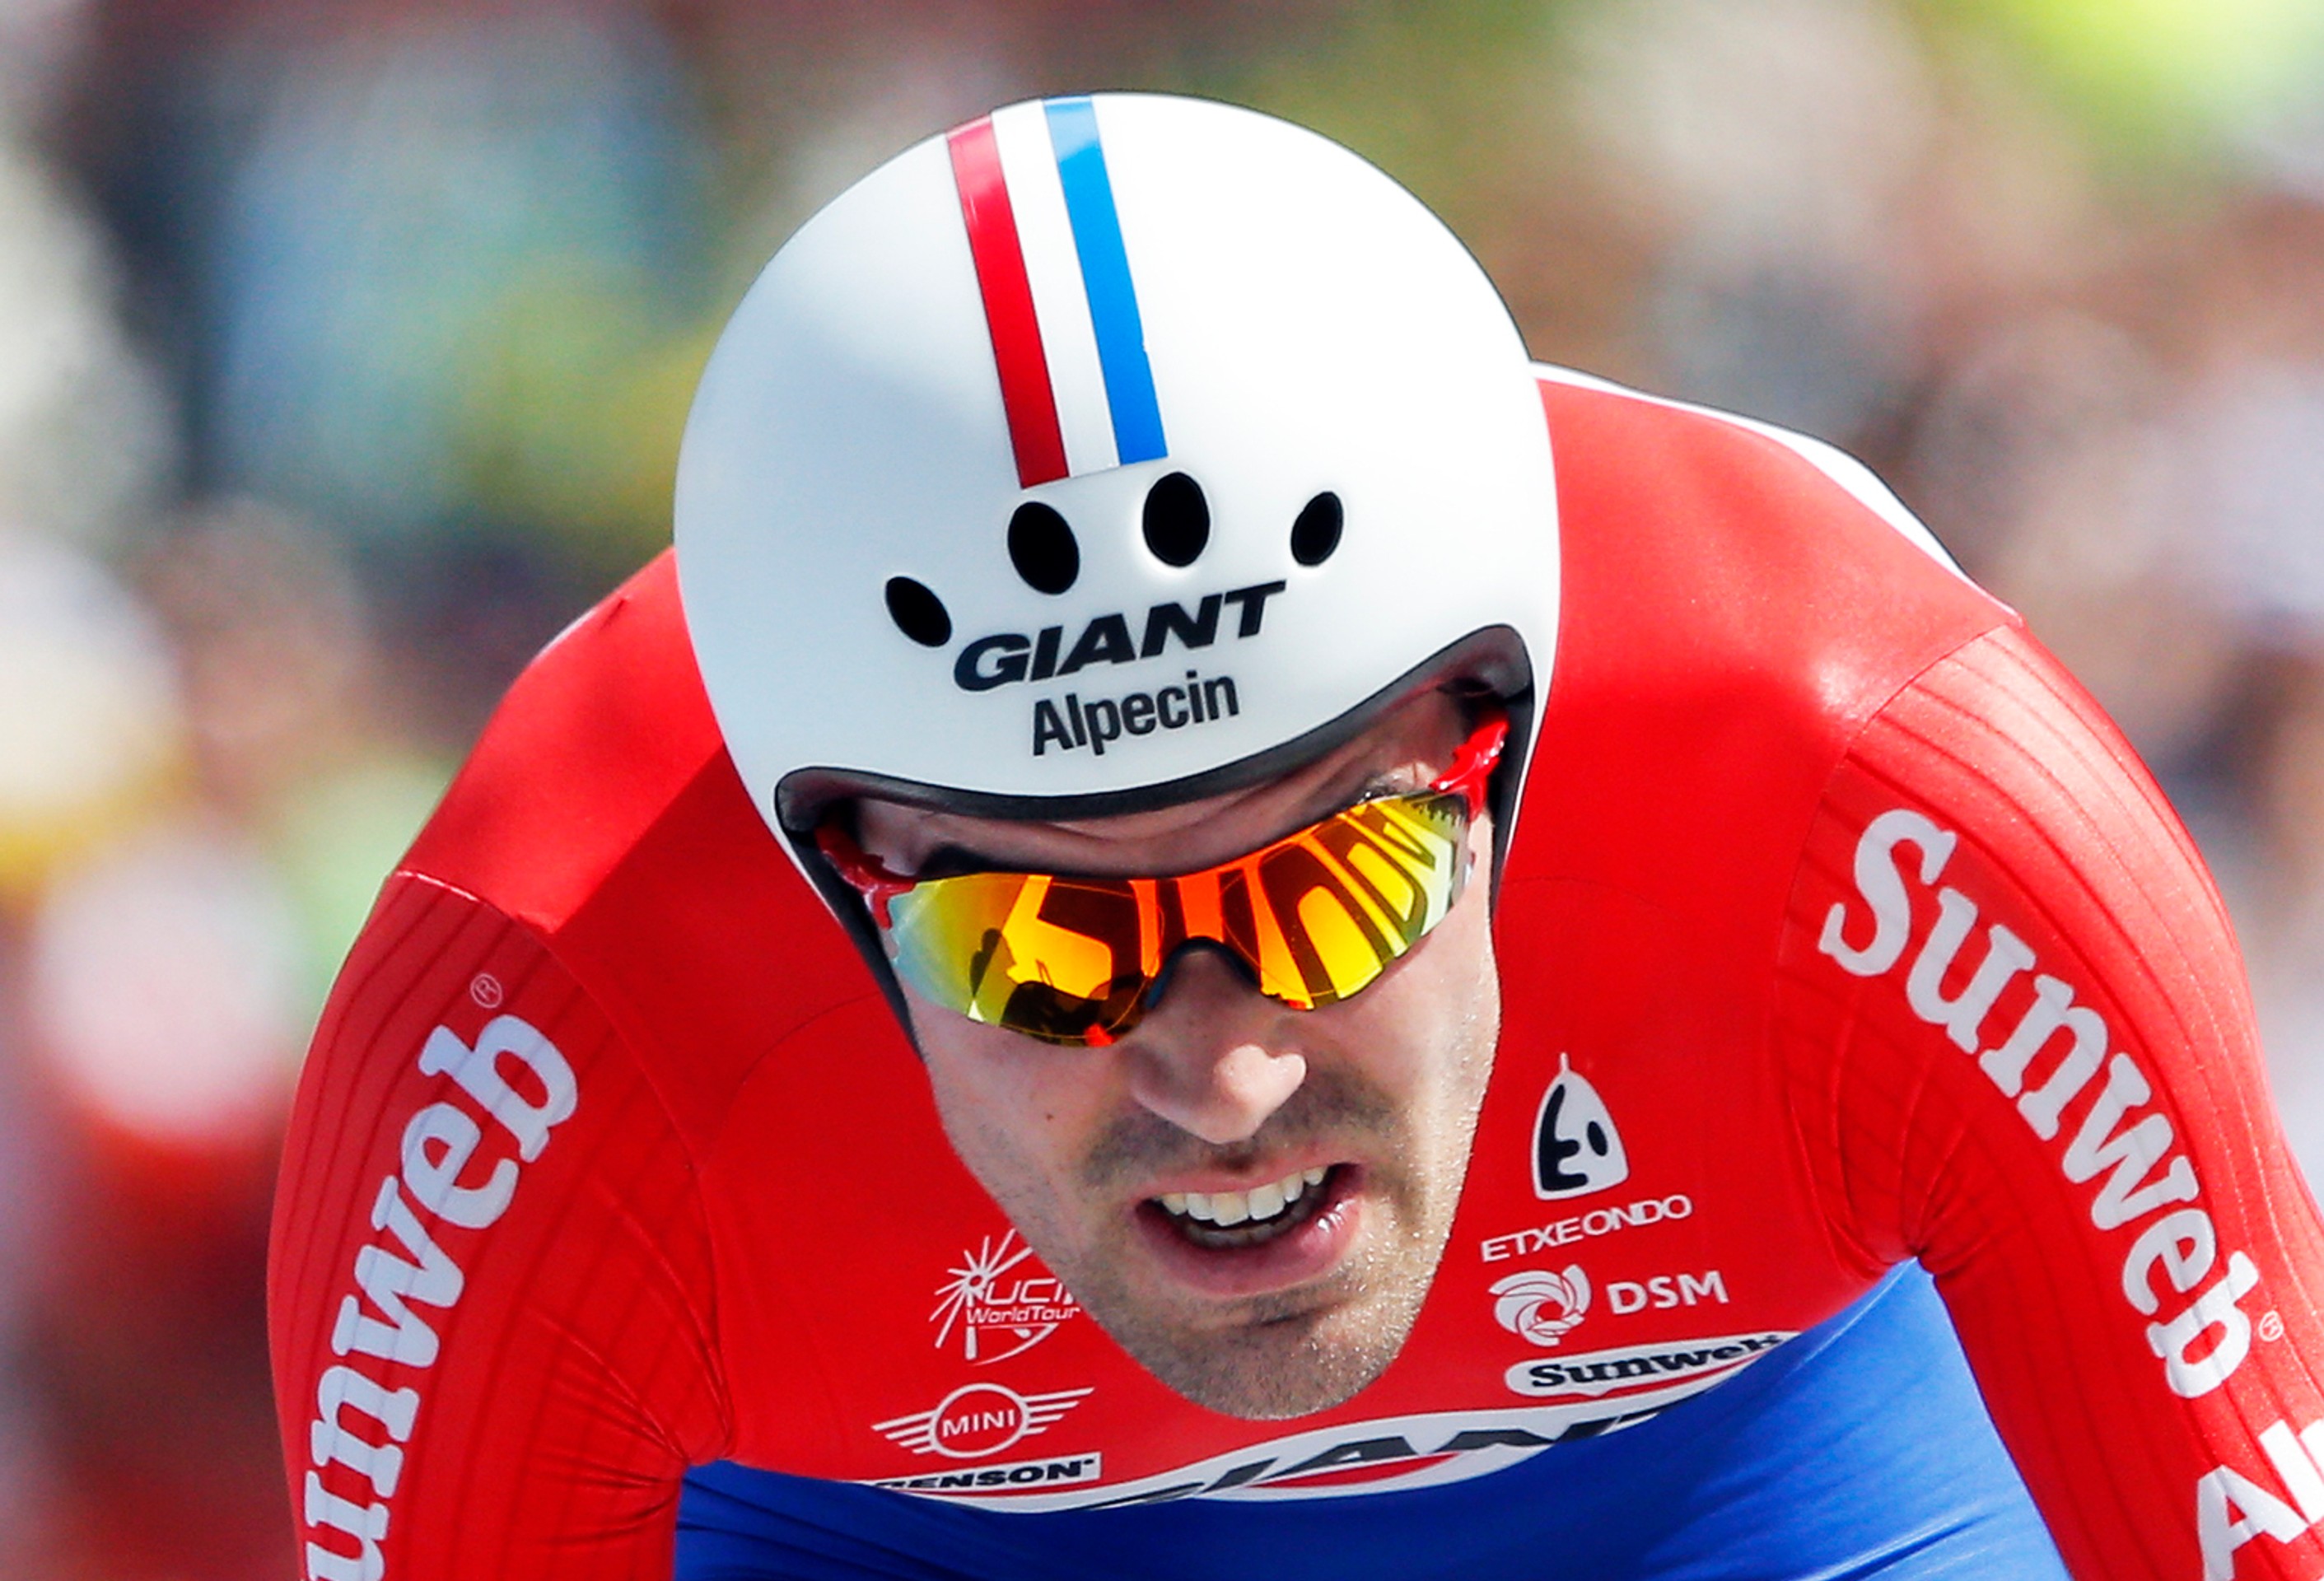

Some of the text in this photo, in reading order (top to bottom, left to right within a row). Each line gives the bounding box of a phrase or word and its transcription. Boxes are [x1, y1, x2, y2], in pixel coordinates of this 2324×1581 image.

[954, 580, 1286, 692] GIANT
[1034, 669, 1239, 757] Alpecin
[1818, 809, 2258, 1397] Sunweb
[1481, 1195, 1692, 1262] ETXEONDO
[1606, 1271, 1729, 1315] DSM
[942, 1409, 1015, 1438] MINI
[875, 1458, 1094, 1488] ENSON
